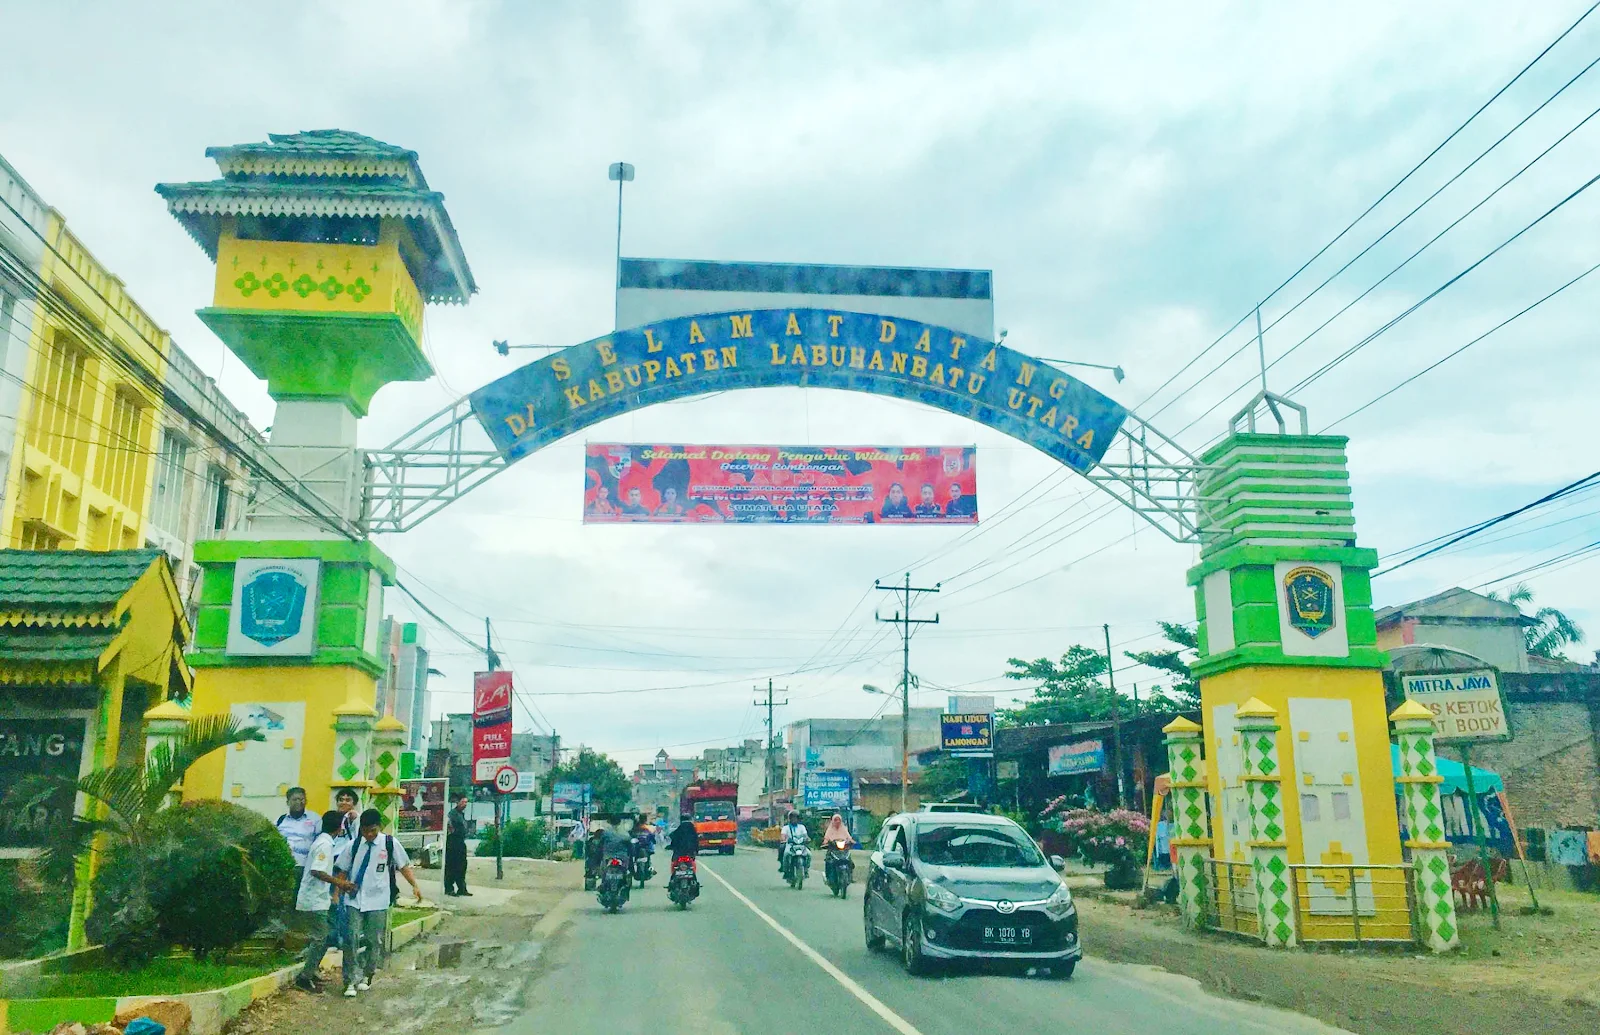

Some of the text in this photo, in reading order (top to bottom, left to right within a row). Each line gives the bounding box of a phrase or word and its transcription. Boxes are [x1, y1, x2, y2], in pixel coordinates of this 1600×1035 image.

[552, 312, 1069, 399] SELAMAT DATANG
[504, 344, 1095, 449] DI KABUPATEN LABUHANBATU UTARA
[641, 449, 922, 462] Selamat Datang Pengurus Wilayah
[772, 462, 845, 472] Rombongan
[690, 492, 768, 501] PEMUDA
[728, 504, 839, 512] SUMATERA UTARA
[1409, 677, 1492, 693] MITRA JAYA
[1446, 699, 1500, 715] KETOK
[964, 715, 989, 723] UDUK
[1456, 717, 1500, 732] BODY
[483, 733, 504, 742] FULL
[945, 738, 988, 746] LAMONGAN
[479, 742, 508, 751] TASTE!
[499, 774, 510, 786] 40
[807, 790, 819, 798] AC
[984, 927, 994, 937] BK
[998, 927, 1016, 937] 1070
